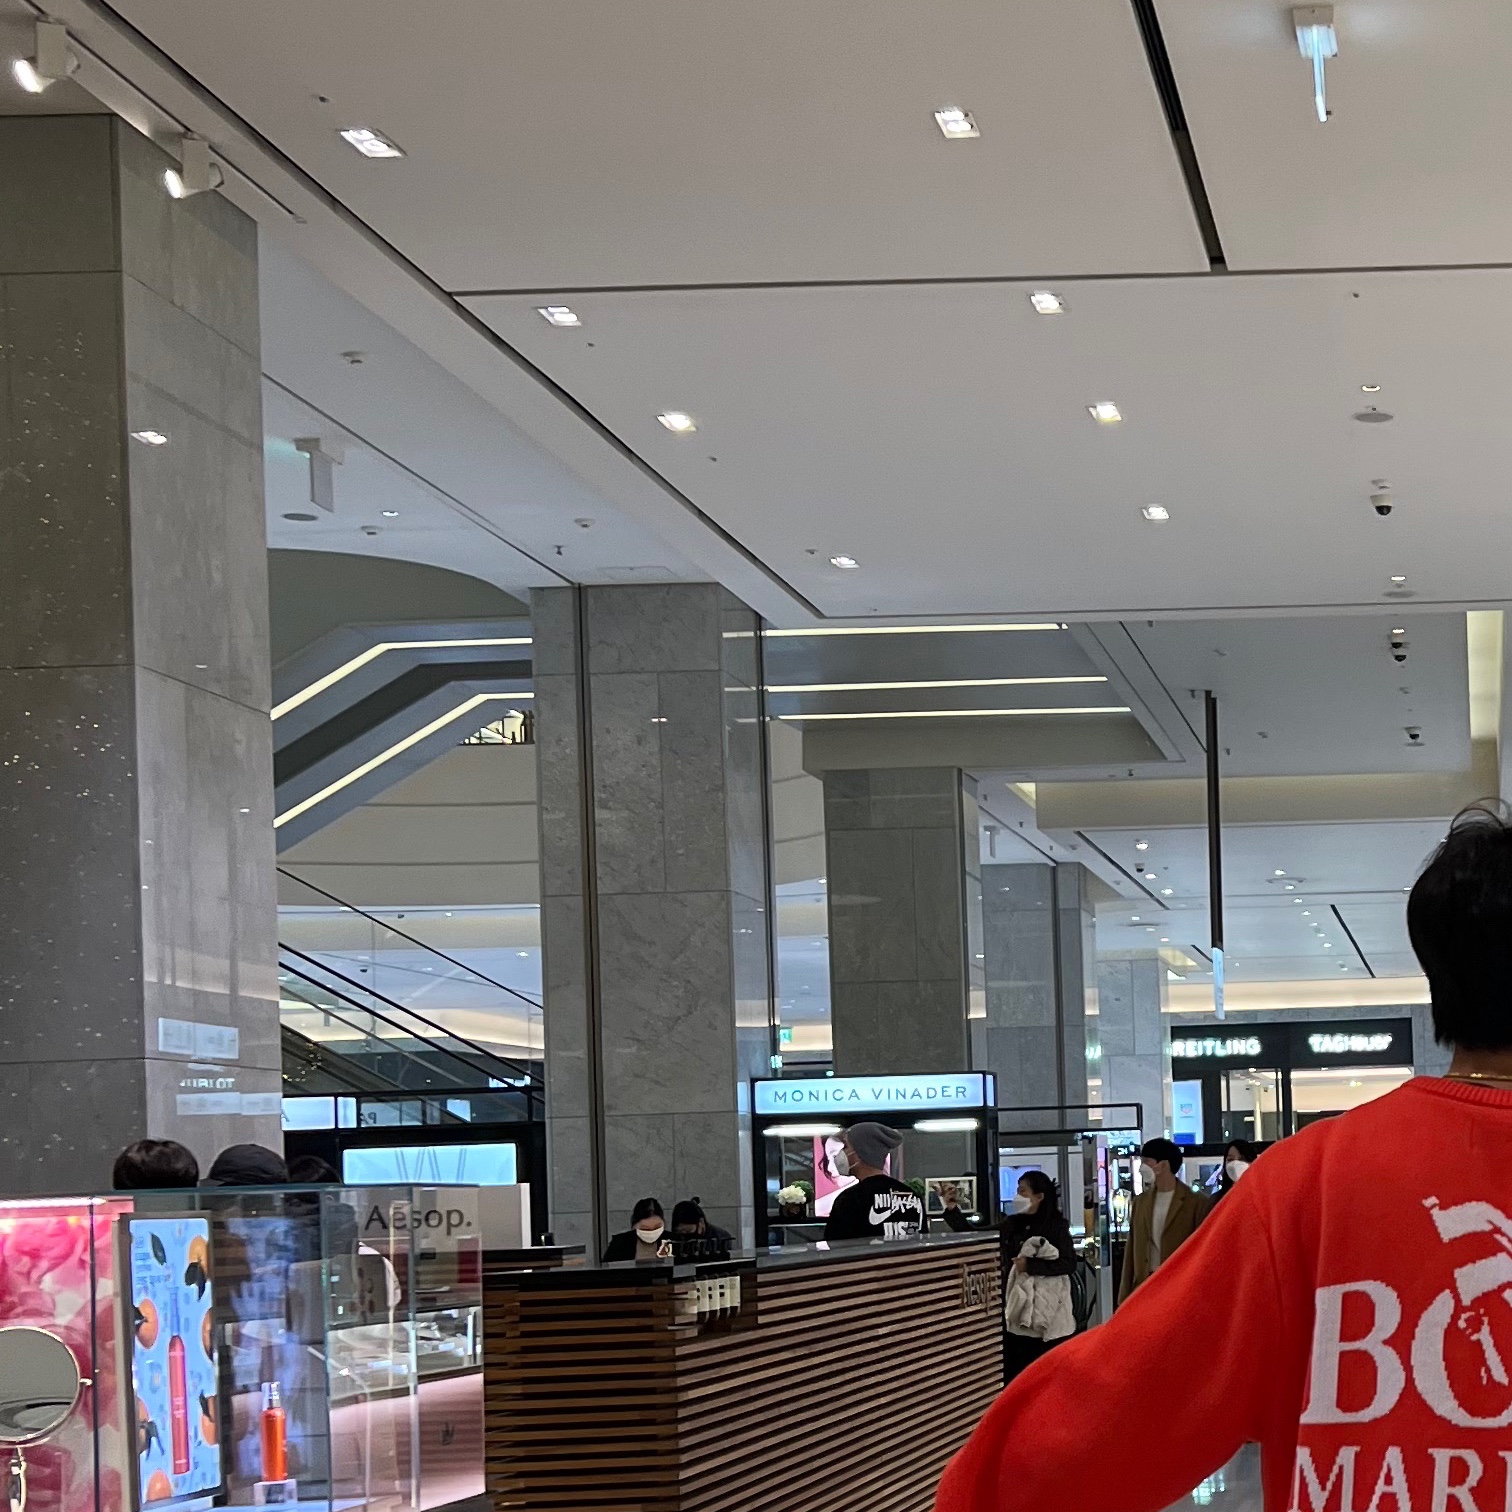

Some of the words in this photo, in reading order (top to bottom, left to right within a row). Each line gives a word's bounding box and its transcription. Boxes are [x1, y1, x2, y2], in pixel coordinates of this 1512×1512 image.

[1168, 1036, 1262, 1058] REITLING
[773, 1088, 861, 1104] MONICA
[871, 1085, 968, 1101] VINADER
